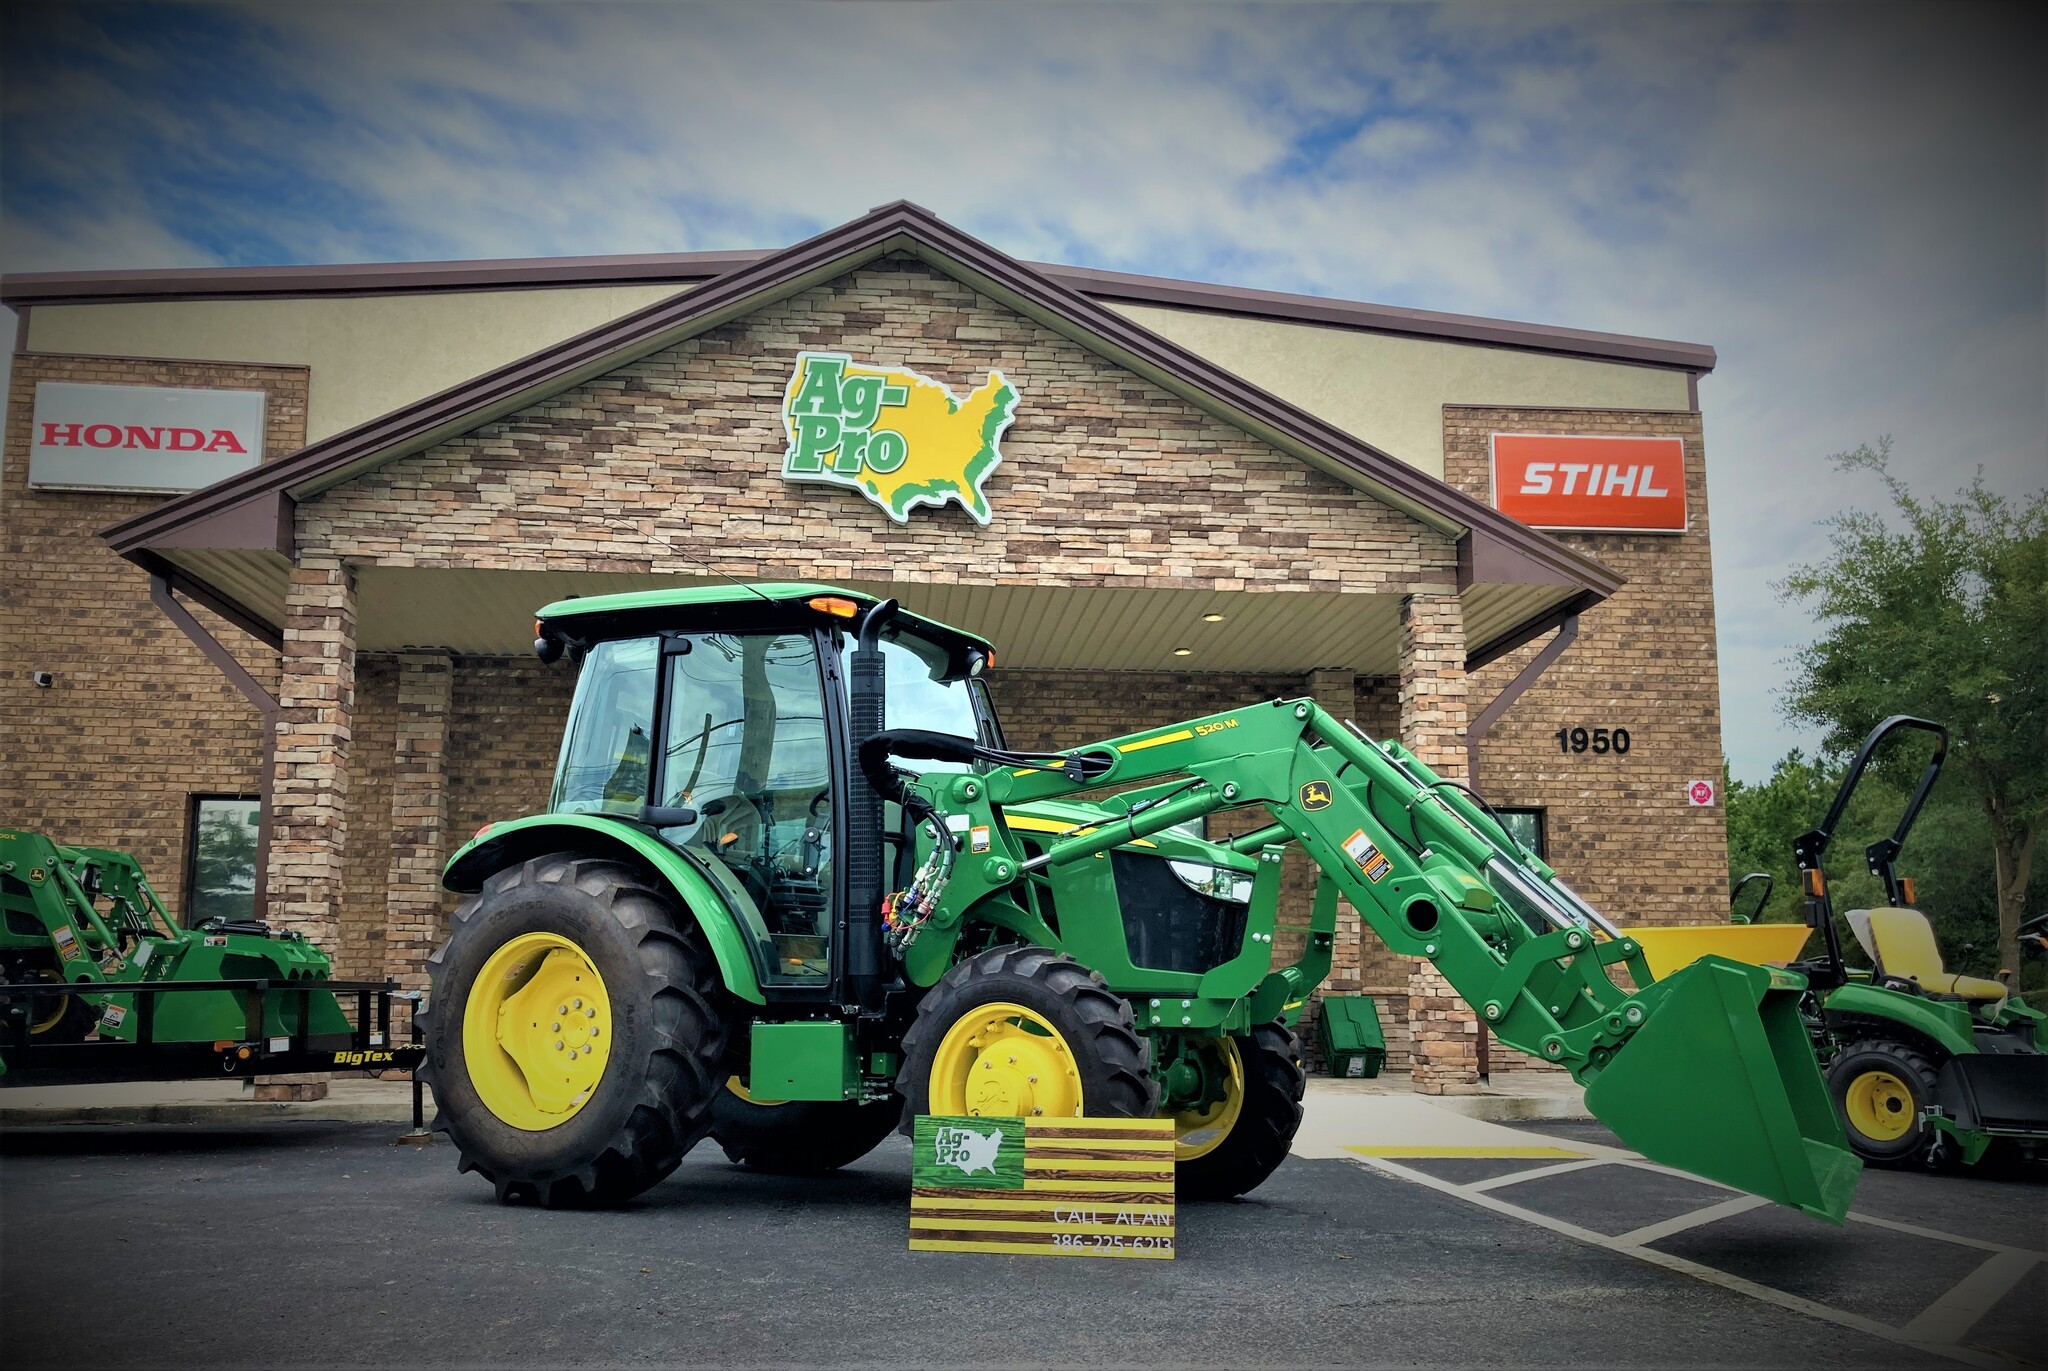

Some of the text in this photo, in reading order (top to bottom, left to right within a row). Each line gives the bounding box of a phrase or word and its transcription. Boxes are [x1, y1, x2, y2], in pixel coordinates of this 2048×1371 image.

[792, 357, 909, 428] Ag-
[40, 423, 247, 453] HONDA
[789, 416, 907, 473] Pro
[1520, 462, 1668, 497] STIHL
[1195, 722, 1224, 736] 520
[1555, 728, 1630, 754] 1950
[938, 1128, 970, 1148] Ag-
[938, 1146, 970, 1163] Pro
[1054, 1207, 1169, 1226] CALL ALAN
[1051, 1235, 1171, 1255] 386-225-6213
